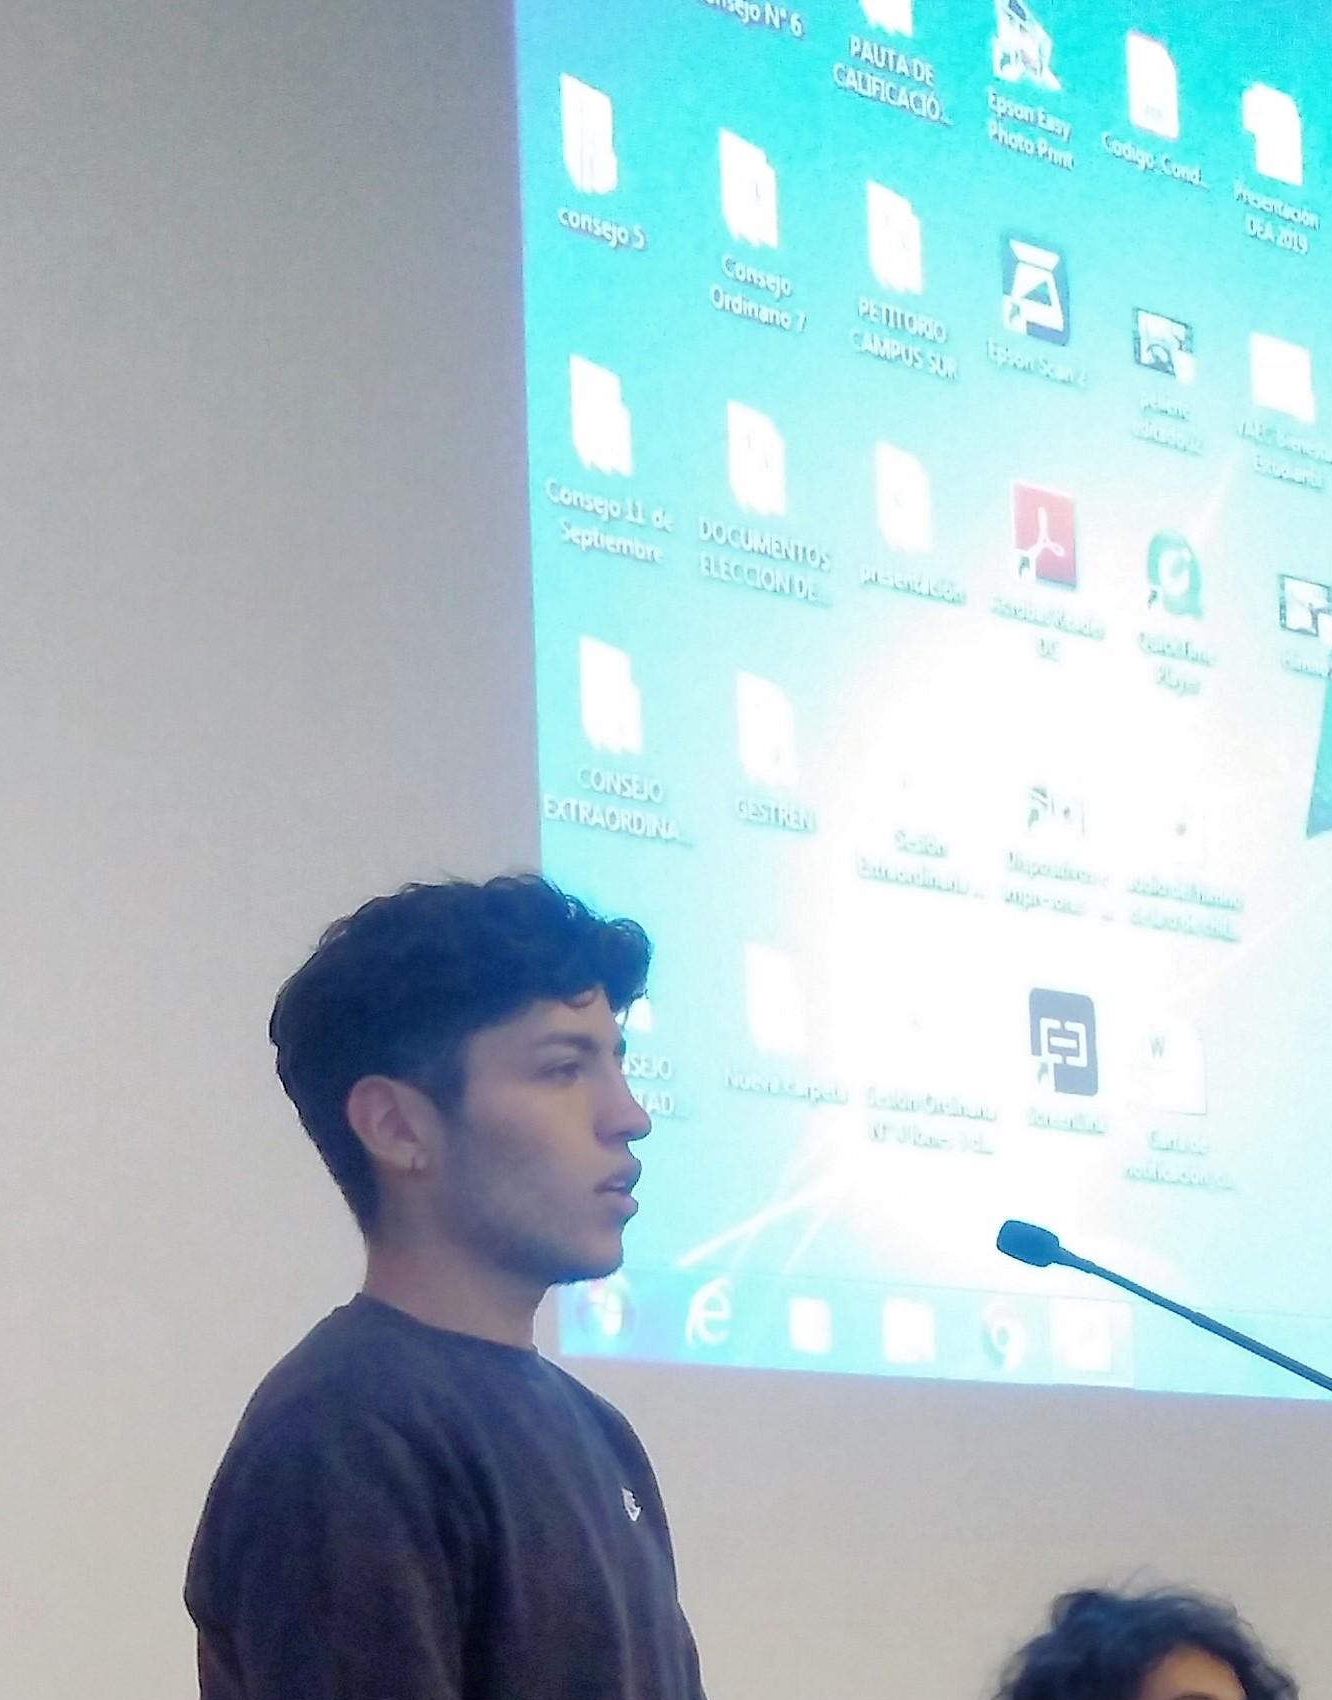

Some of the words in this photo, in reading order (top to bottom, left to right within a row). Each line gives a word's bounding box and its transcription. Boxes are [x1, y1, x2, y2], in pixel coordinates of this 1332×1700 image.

[790, 12, 804, 37] 6
[850, 35, 909, 76] PAUTA
[912, 59, 936, 86] DE
[988, 87, 1036, 123] Epson
[1037, 108, 1072, 143] Easy
[987, 119, 1034, 156] Photo
[1036, 133, 1074, 170] Print
[557, 207, 629, 248] consejo
[721, 254, 793, 301] Consejo
[858, 296, 948, 344] PETITORIO
[851, 328, 924, 370] CAMPUS
[928, 348, 958, 380] SUR
[545, 478, 621, 522] Consejo
[560, 516, 664, 563] Septiembre
[698, 516, 831, 572] DOCUMENTOS
[578, 767, 664, 804] CONSEJO
